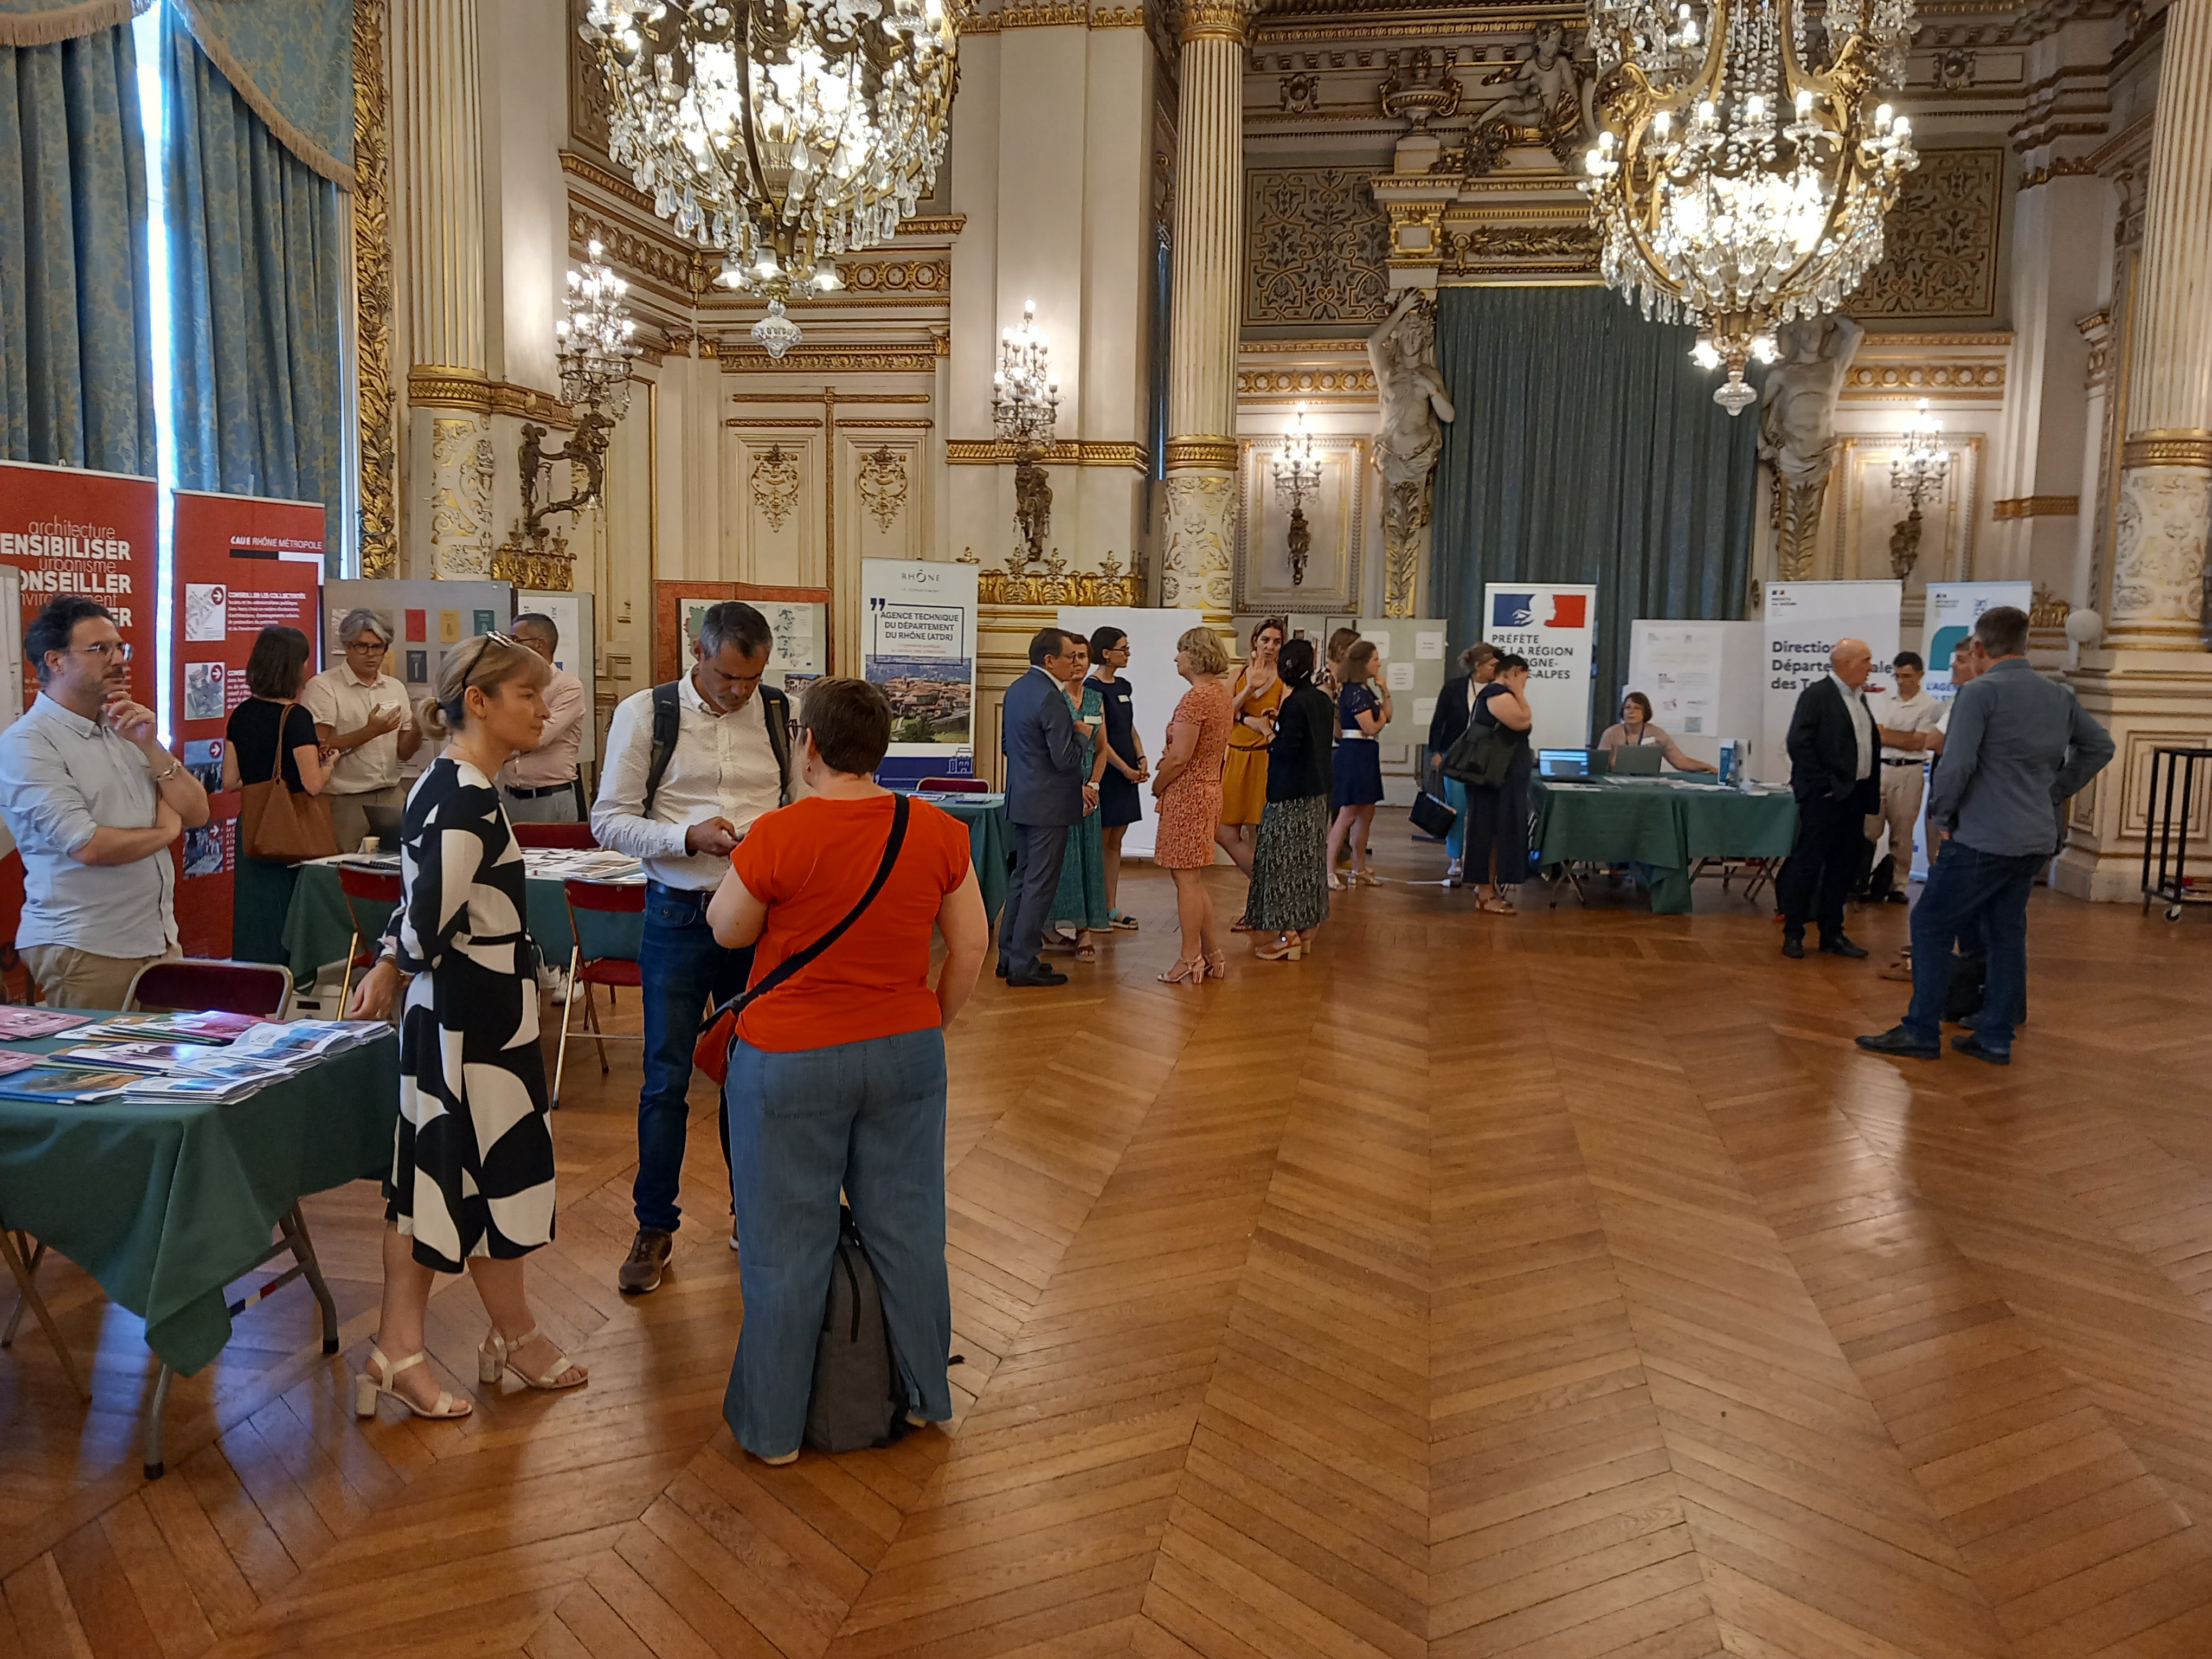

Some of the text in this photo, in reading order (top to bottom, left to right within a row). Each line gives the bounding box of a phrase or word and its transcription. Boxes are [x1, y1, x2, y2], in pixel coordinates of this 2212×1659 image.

[28, 515, 115, 539] architecture
[0, 532, 132, 561] ENSIBILISER
[230, 535, 322, 550] CAUE RHÔNE MÉTROPOLE
[38, 558, 117, 574] urbanisme
[20, 569, 132, 594] ONSEILLER
[902, 569, 941, 583] RHÔNE
[880, 612, 959, 622] AGENCE TECHNIQUE
[898, 621, 954, 631] DÉPARTEMENT
[898, 631, 927, 640] RHÔNE
[927, 633, 953, 641] (ATDR)
[1528, 645, 1573, 656] RÉGION
[1772, 641, 1835, 653] Directio
[1771, 677, 1797, 690] des
